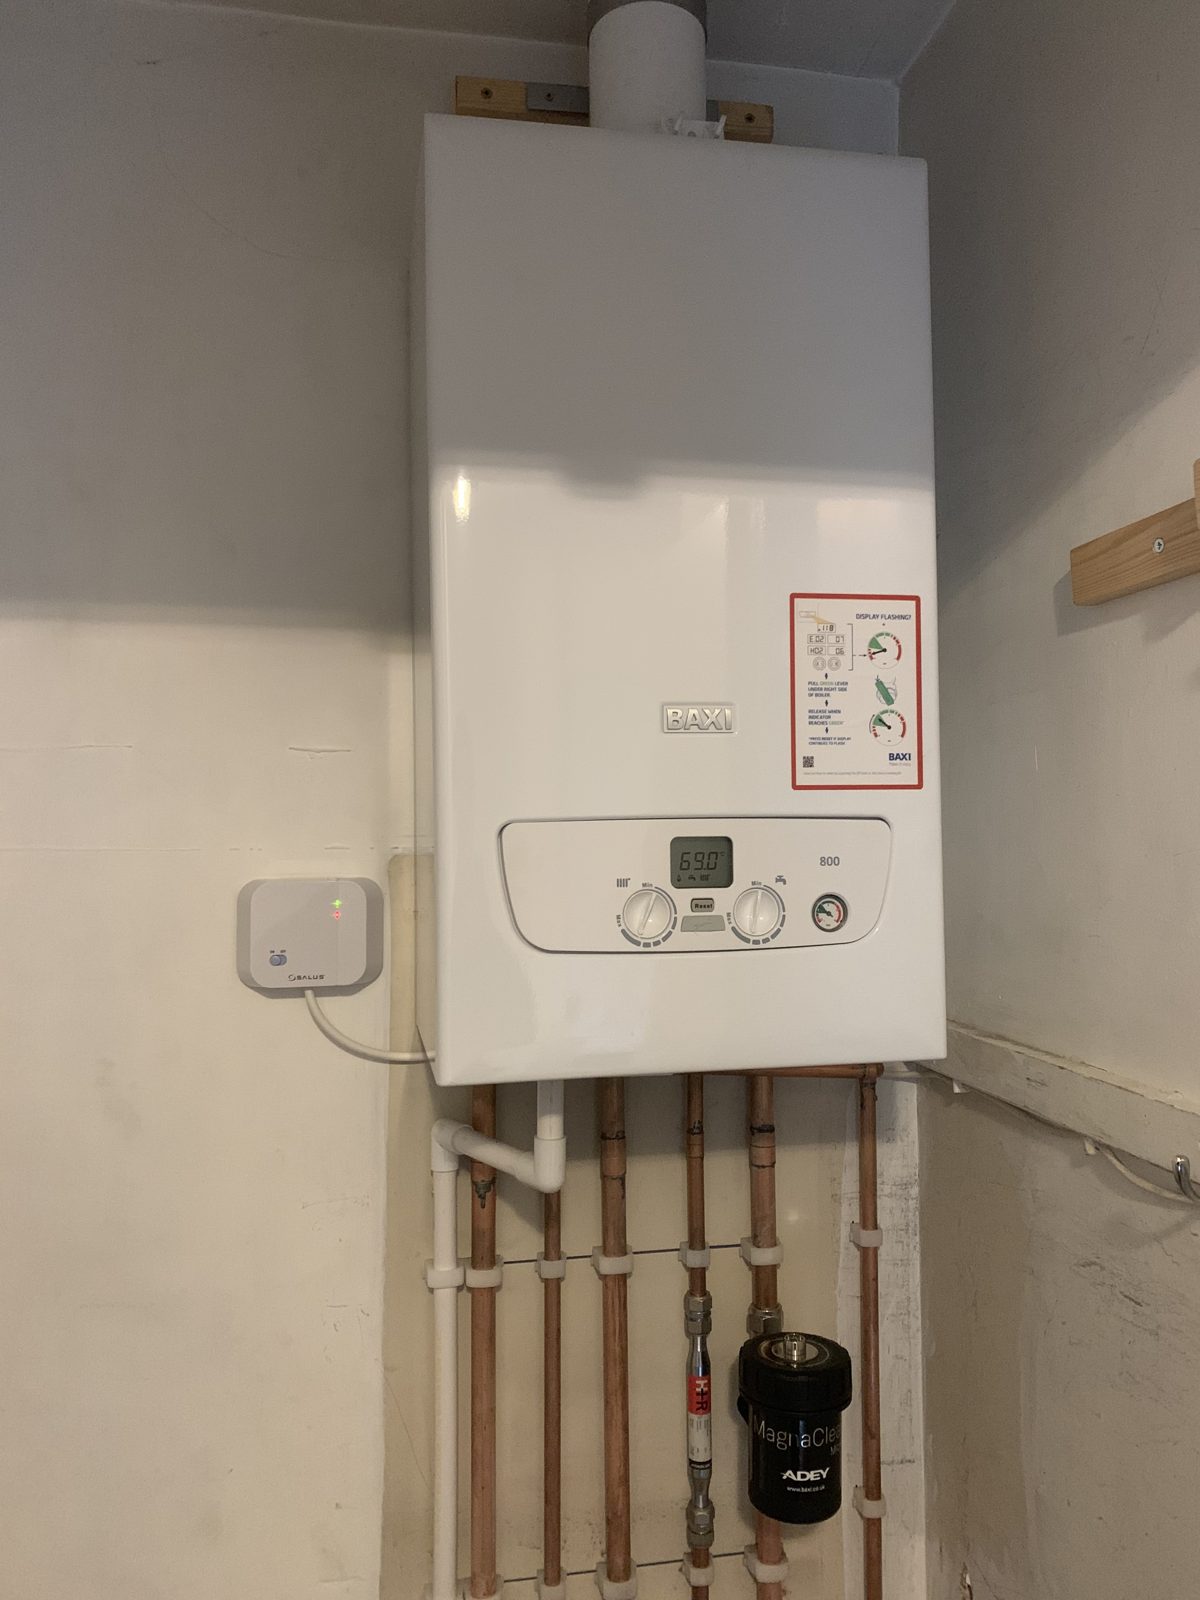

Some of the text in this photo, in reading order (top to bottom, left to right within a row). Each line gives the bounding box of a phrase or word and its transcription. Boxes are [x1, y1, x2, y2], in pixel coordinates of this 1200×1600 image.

[665, 708, 732, 731] BAXI
[888, 753, 911, 761] BAXI
[819, 856, 840, 866] 800
[782, 1467, 830, 1481] ADEY
